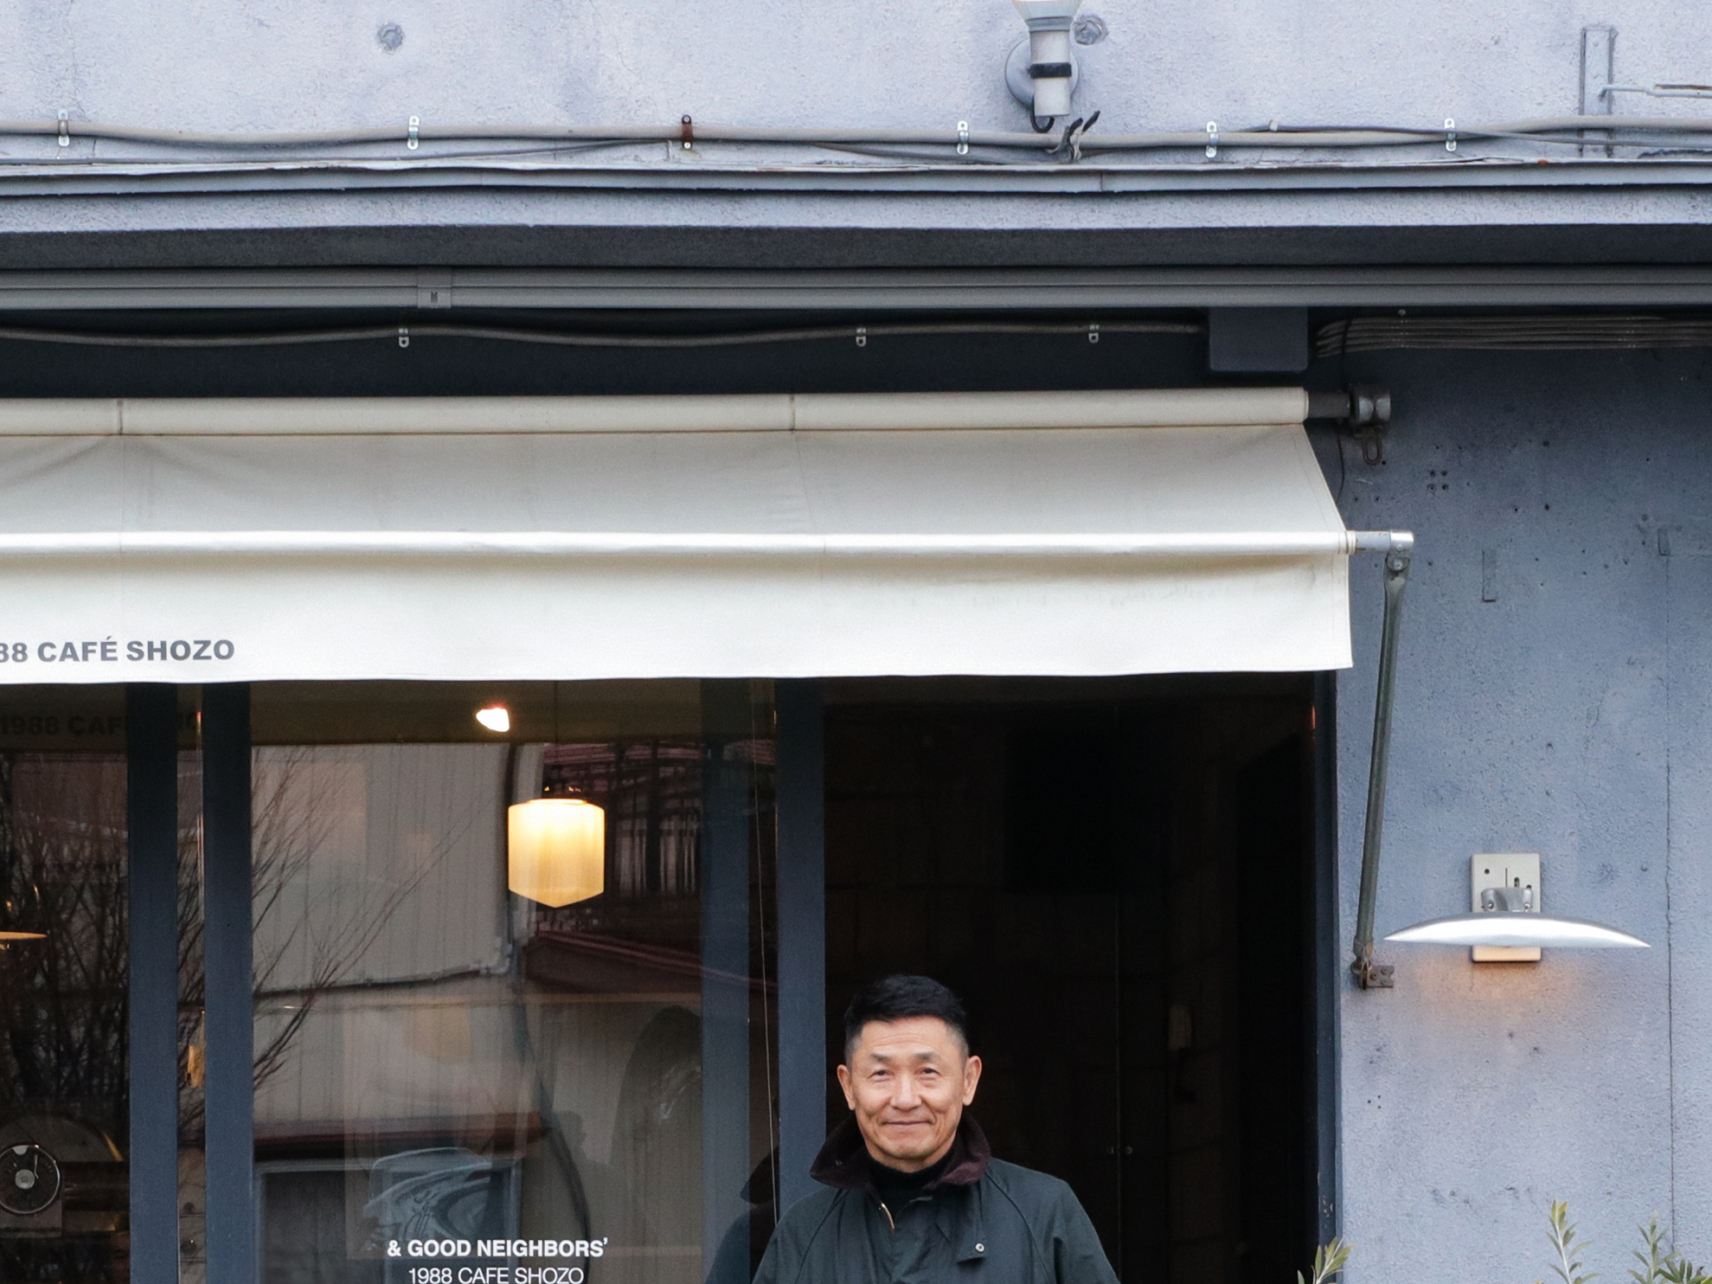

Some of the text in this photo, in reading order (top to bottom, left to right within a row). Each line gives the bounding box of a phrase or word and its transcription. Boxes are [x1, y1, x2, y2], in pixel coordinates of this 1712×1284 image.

[37, 636, 118, 662] CAFÉ
[126, 640, 235, 661] SHOZO
[68, 715, 127, 737] CAF
[387, 1240, 401, 1257] &
[407, 1240, 471, 1257] GOOD
[408, 1267, 584, 1284] 1988 CAFE SHOZO
